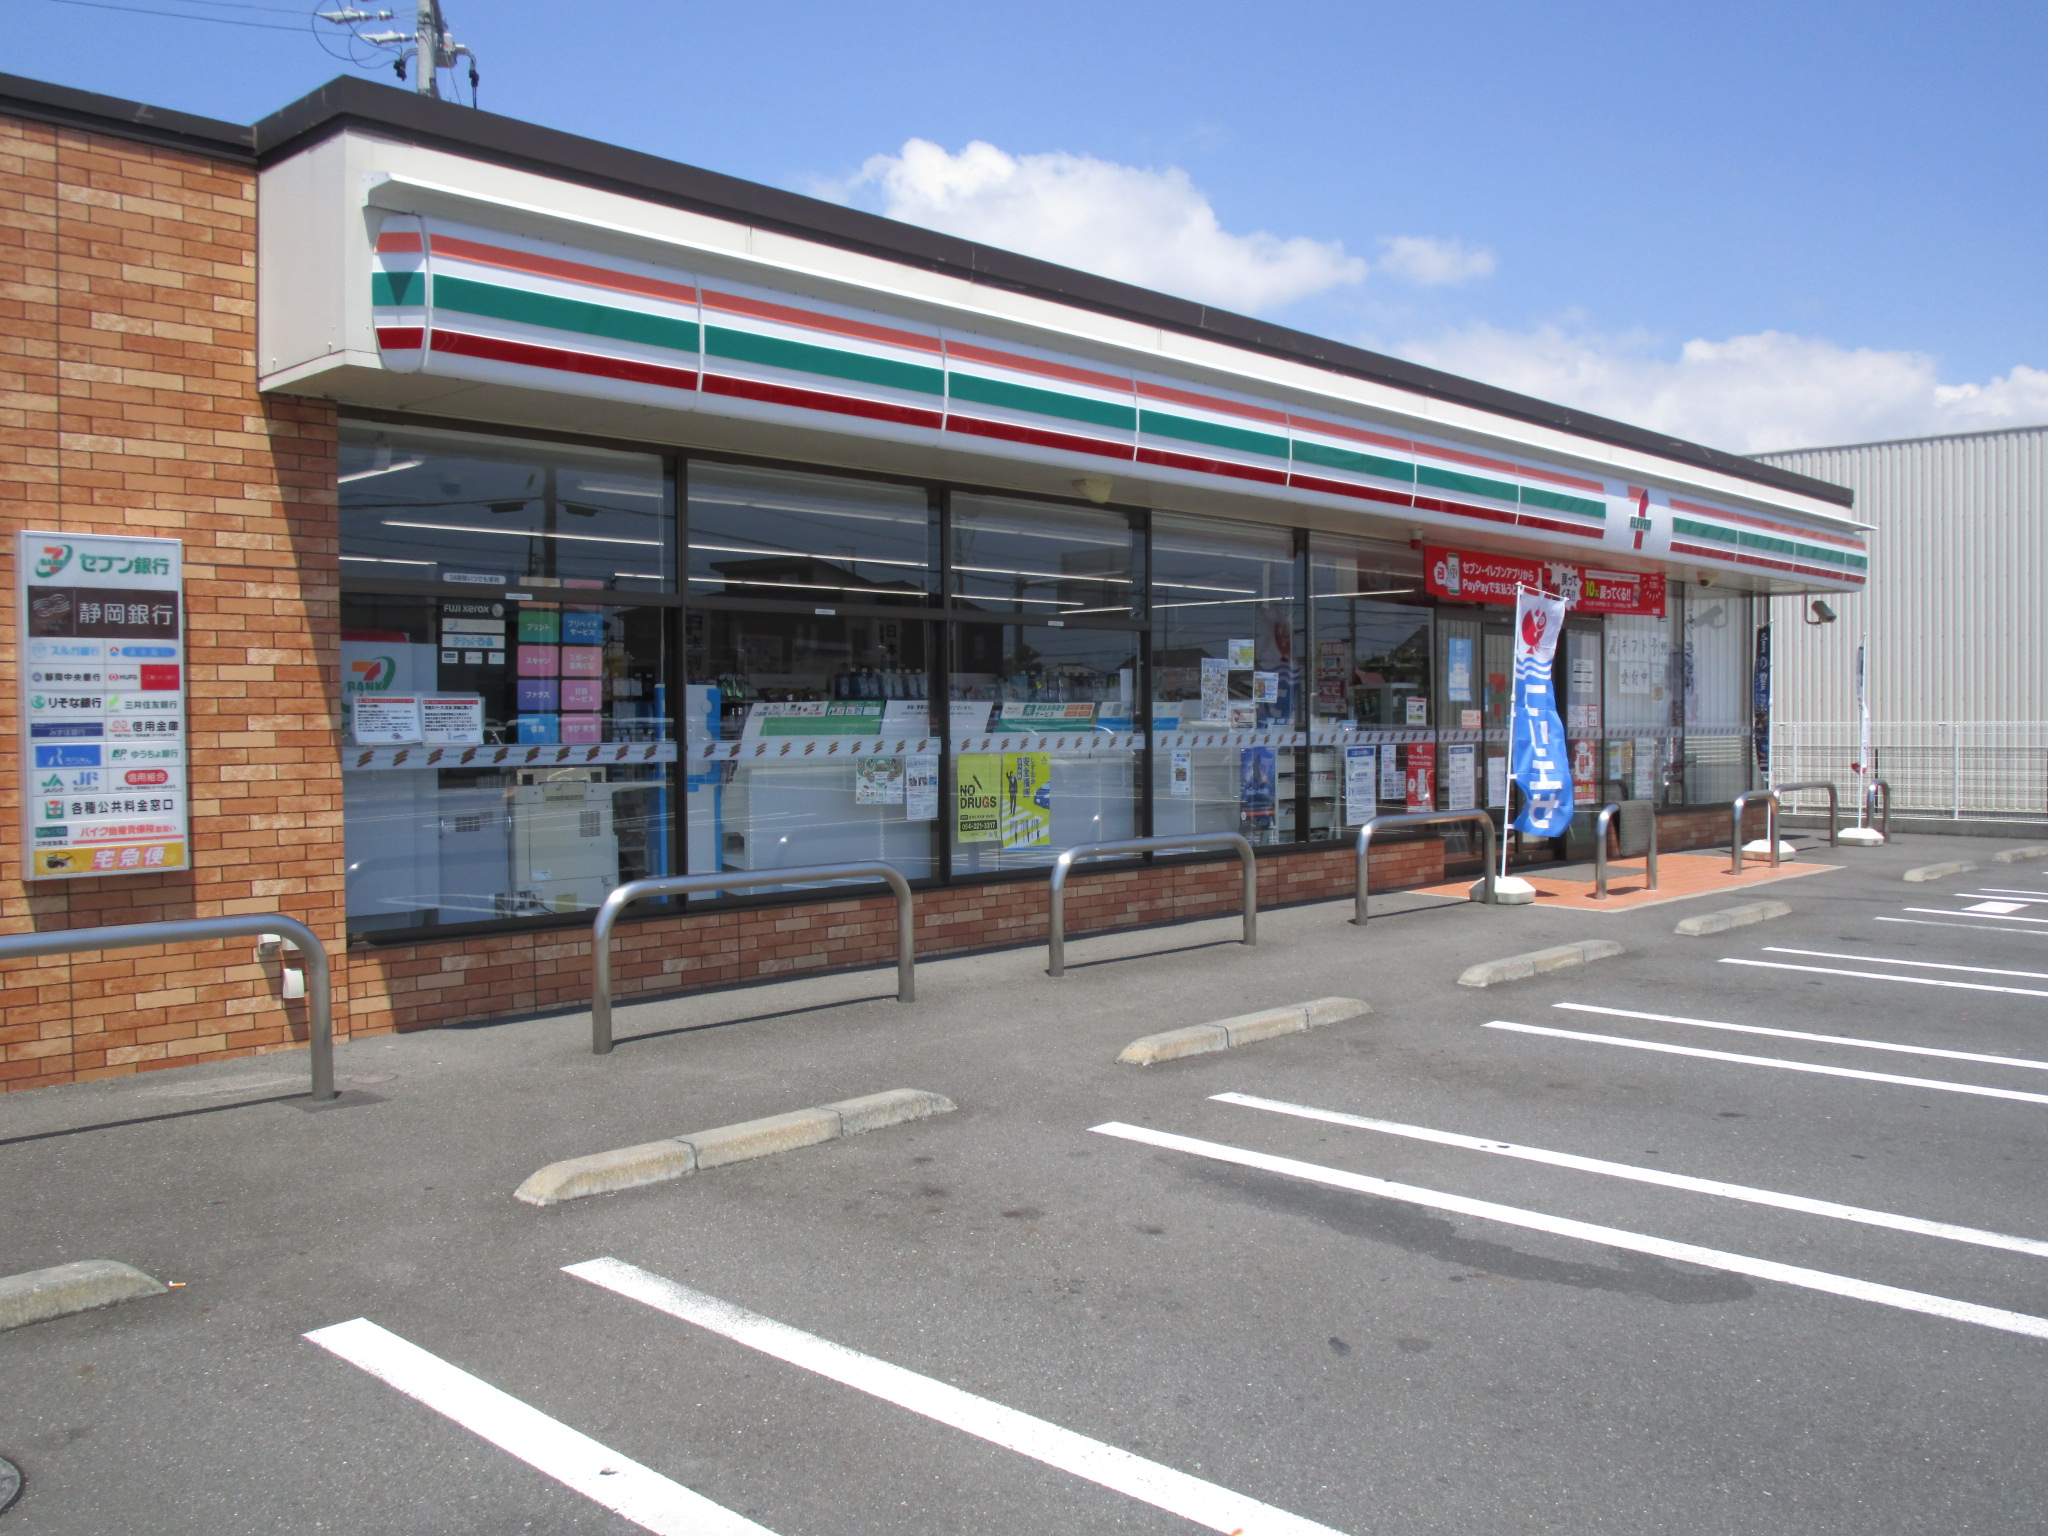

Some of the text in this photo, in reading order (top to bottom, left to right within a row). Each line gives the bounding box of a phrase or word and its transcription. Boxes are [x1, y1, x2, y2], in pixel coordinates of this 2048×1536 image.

[79, 553, 169, 575] セブン銀行
[1561, 572, 1578, 586] 戻って
[1462, 578, 1518, 596] PayPayで支払うと
[79, 602, 173, 625] 静岡銀行
[443, 604, 461, 613] FUJI
[526, 623, 551, 631] プリント
[567, 619, 598, 628] プリペイド
[570, 628, 595, 636] サービス
[452, 636, 494, 647] チケットぴあ
[50, 645, 100, 657] スルガ銀行
[525, 657, 551, 665] スキャン
[44, 672, 100, 682] 静岡中央銀行
[48, 697, 101, 708] りそな銀行
[124, 700, 177, 709] 三井住友銀行
[132, 720, 179, 732] 信用金庫
[49, 728, 86, 736] みずほ銀行
[131, 749, 178, 759] ゆうちょ銀行
[127, 773, 165, 783] 信用組合
[960, 785, 976, 796] NO
[71, 799, 174, 815] 各種公共料金窓口
[960, 796, 997, 809] DRUGS
[94, 846, 165, 869] 宅急便
